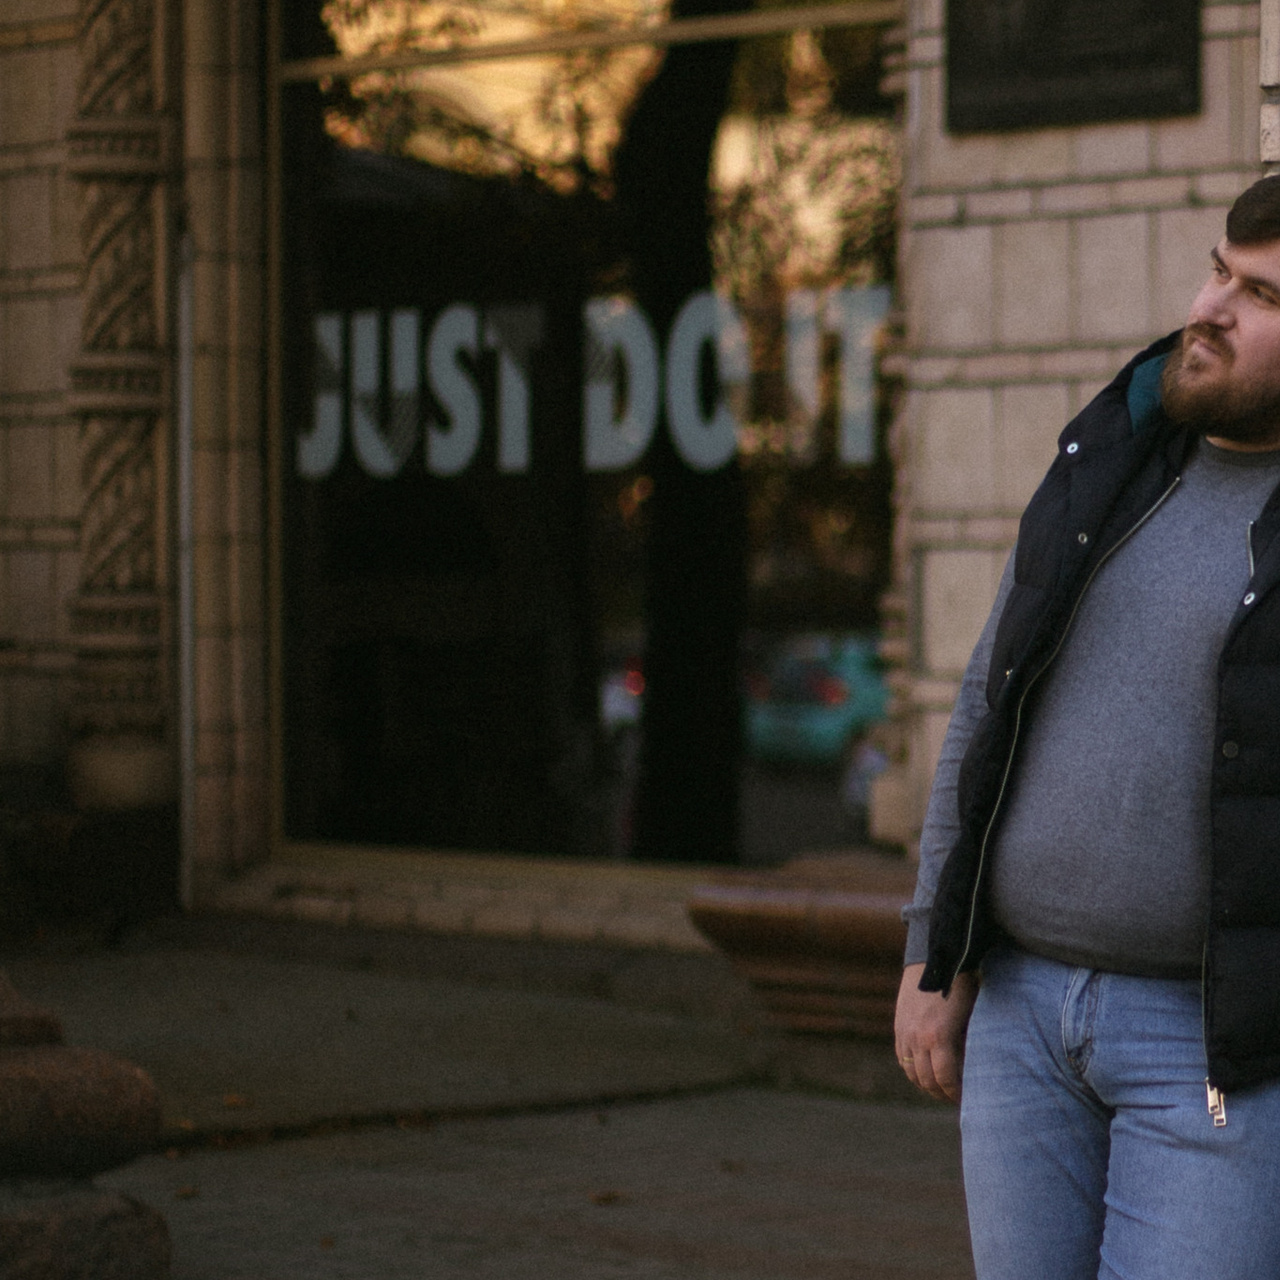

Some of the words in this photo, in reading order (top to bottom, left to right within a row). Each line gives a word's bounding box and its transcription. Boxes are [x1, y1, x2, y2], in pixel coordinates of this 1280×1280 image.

[299, 303, 543, 478] JUST
[584, 291, 752, 472] DO
[786, 287, 891, 468] IT
